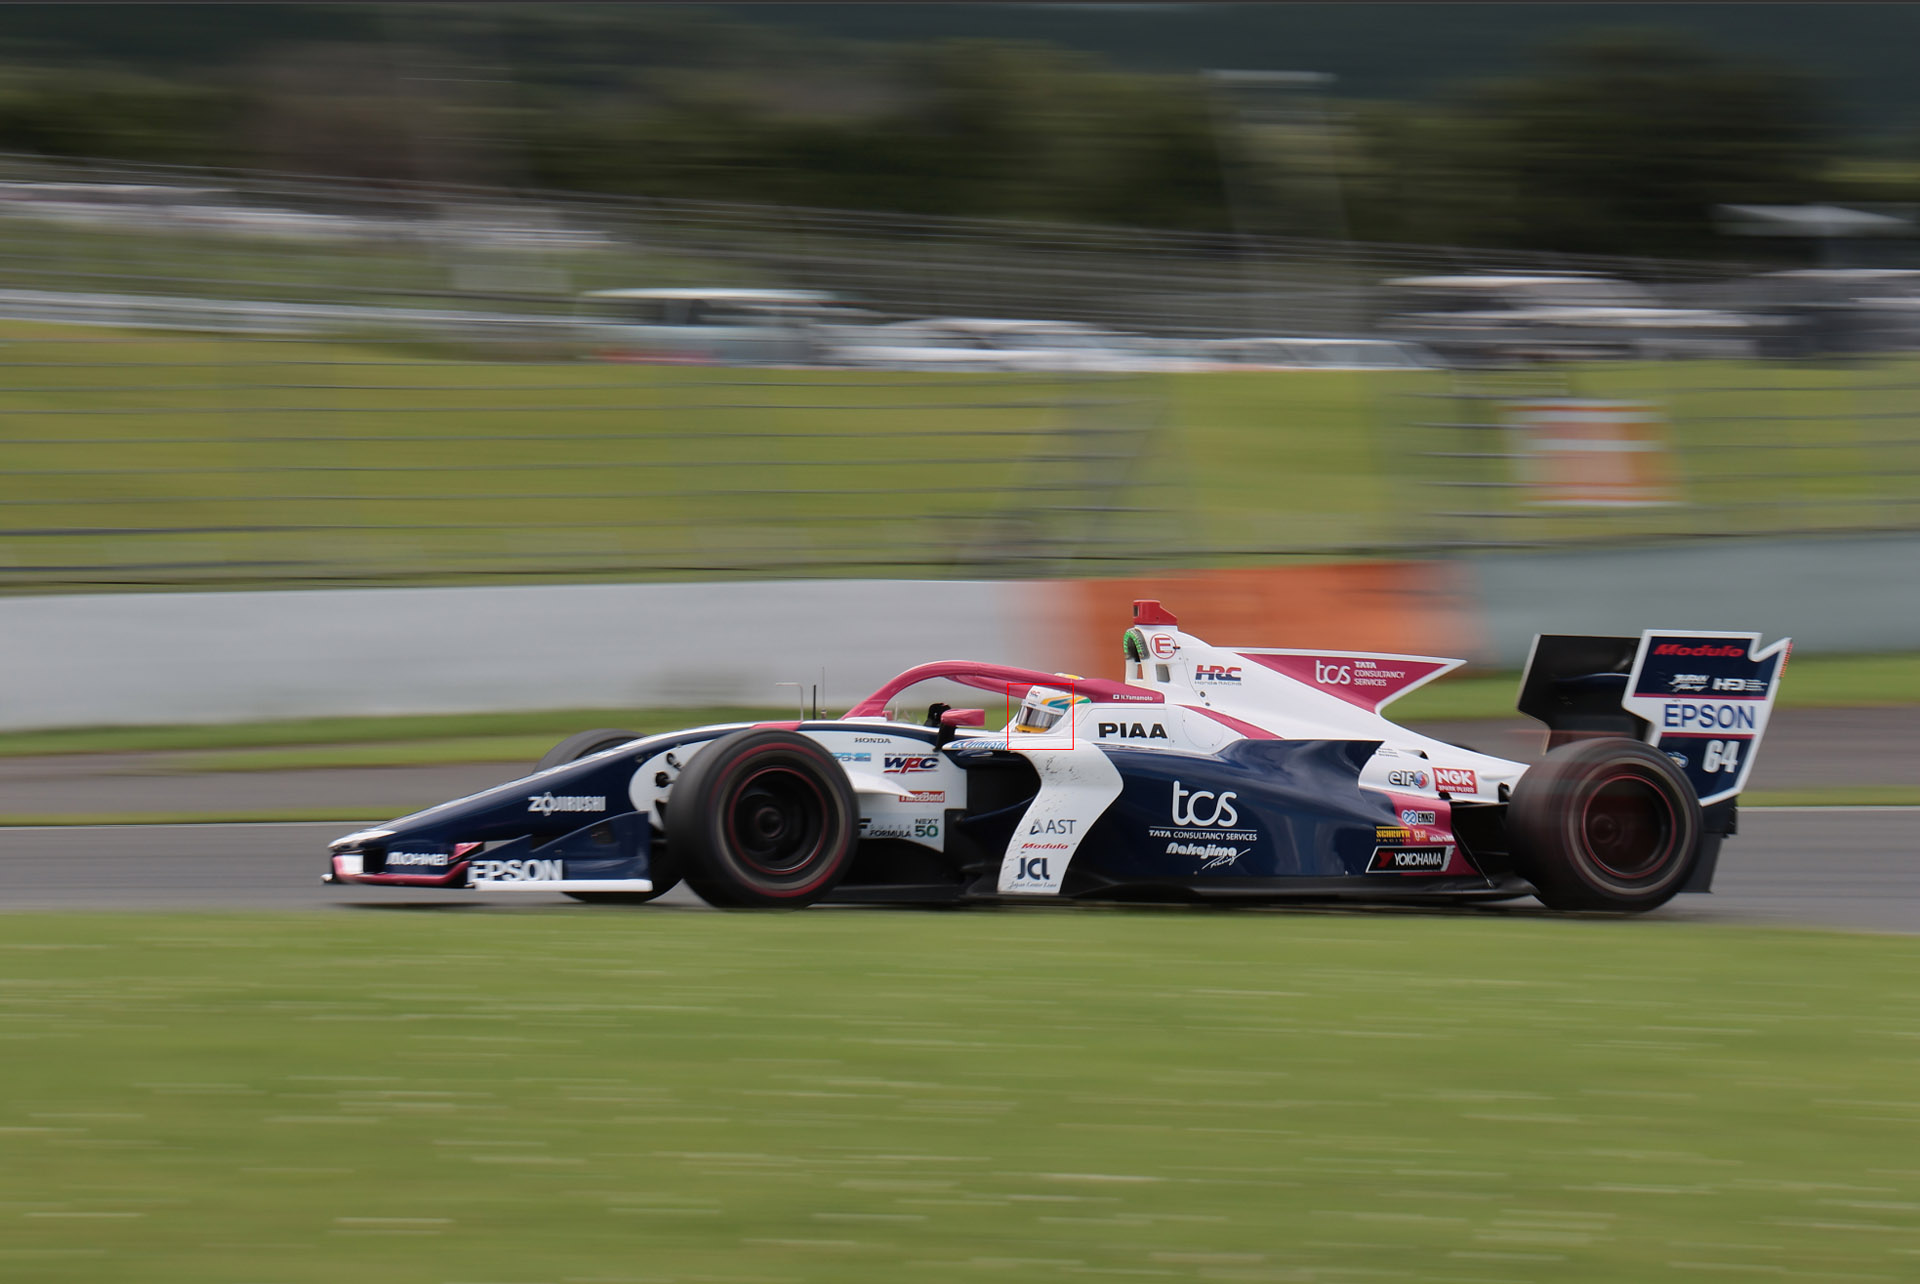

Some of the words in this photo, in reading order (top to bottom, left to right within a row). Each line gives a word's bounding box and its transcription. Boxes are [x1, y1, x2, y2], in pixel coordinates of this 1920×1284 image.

[1653, 644, 1744, 657] Modulo
[1195, 664, 1242, 681] HRC
[1315, 660, 1351, 685] tcs
[1354, 669, 1405, 678] CONSULTANCY
[1354, 678, 1387, 686] SERVICES
[1664, 703, 1755, 729] EPSON
[1098, 723, 1168, 739] PIAA
[1702, 740, 1740, 773] 64
[884, 757, 939, 774] WPC
[1389, 770, 1415, 786] elf
[1435, 769, 1473, 786] NGK
[528, 792, 606, 816] ZOJIRUSHI
[1172, 780, 1238, 827] tcs
[869, 829, 912, 838] FORMULA
[915, 825, 939, 837] 50
[1173, 831, 1225, 840] CONSULTANCY
[1226, 832, 1257, 841] SERVICES
[1394, 852, 1442, 866] YOKOHAMA
[467, 859, 563, 881] EPSON
